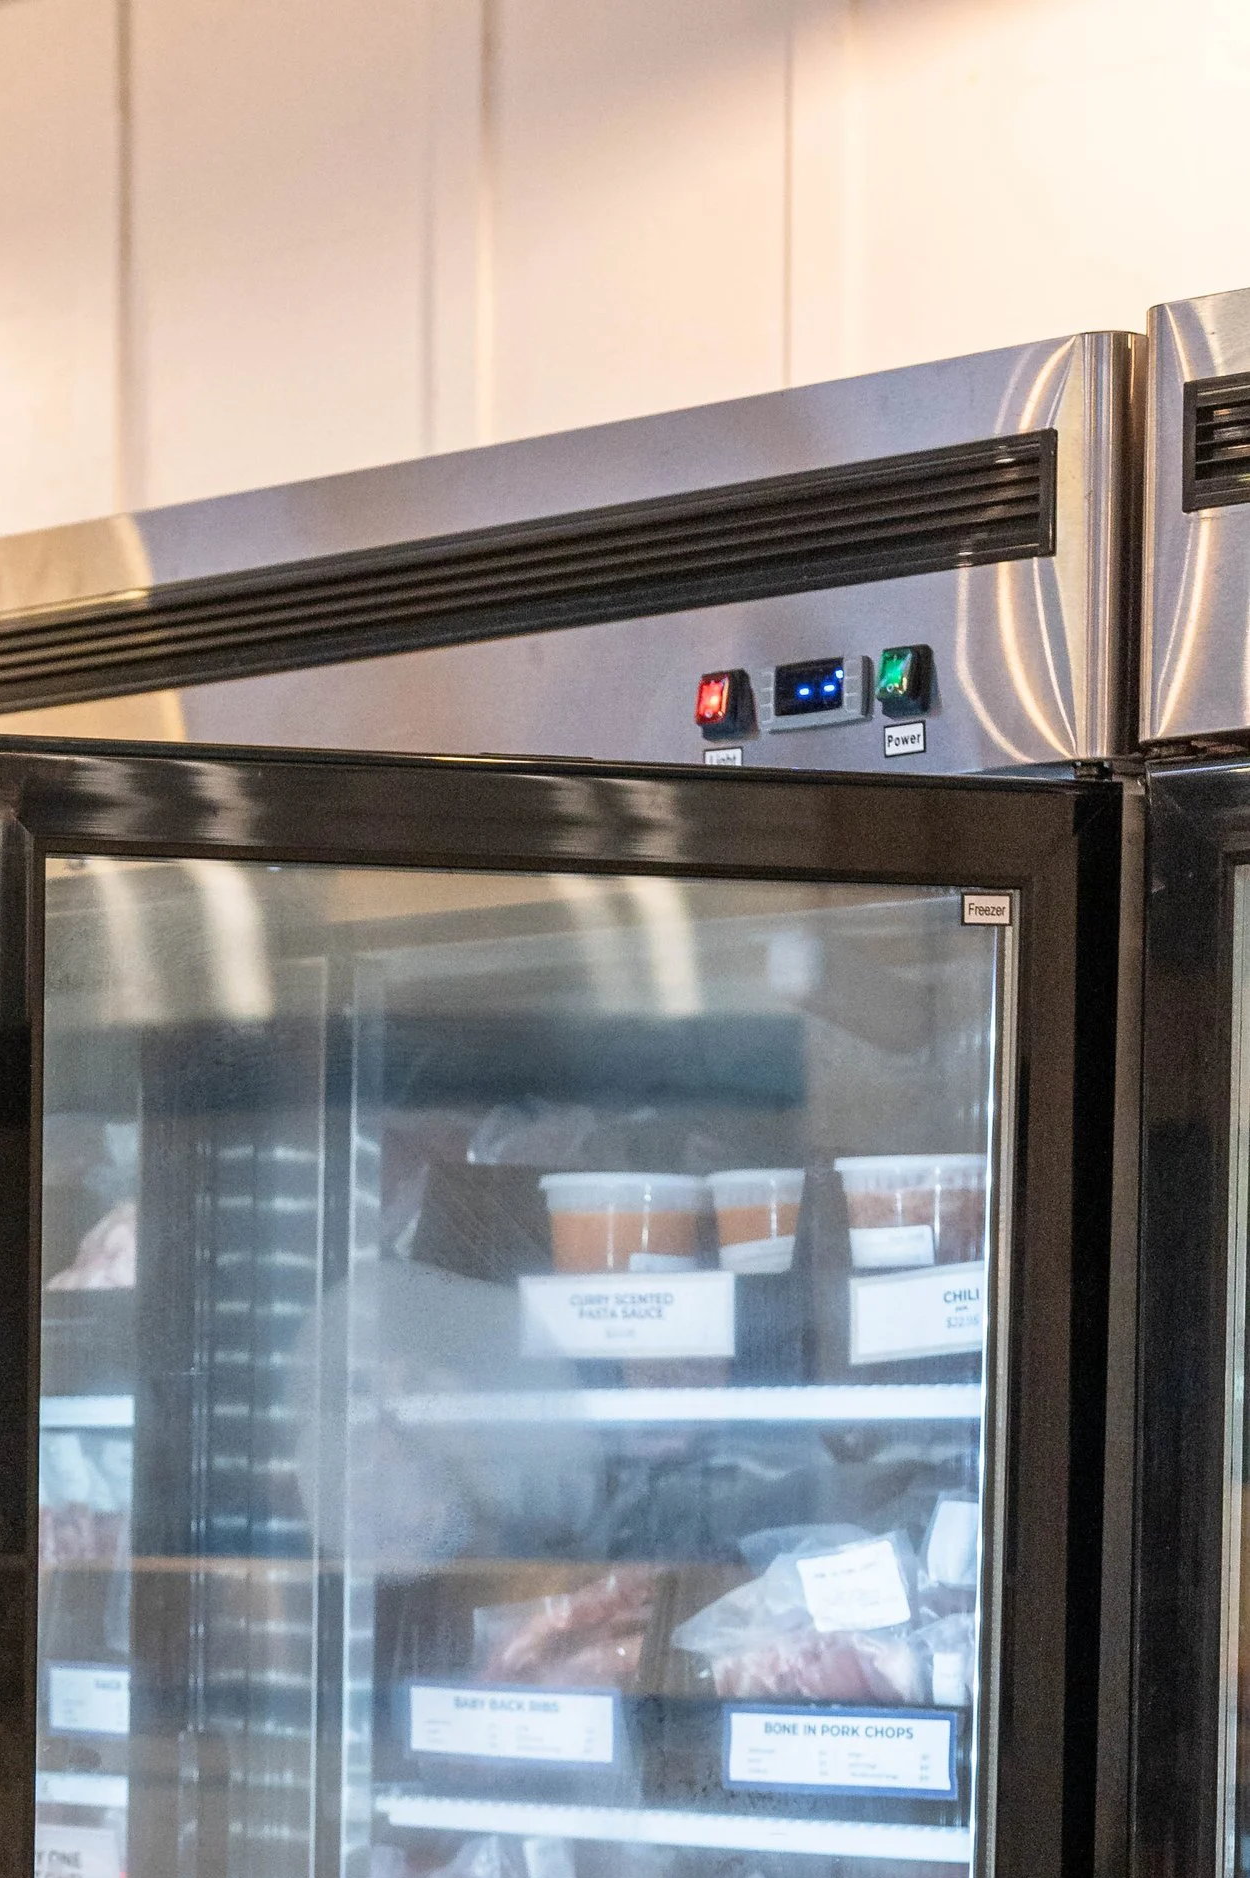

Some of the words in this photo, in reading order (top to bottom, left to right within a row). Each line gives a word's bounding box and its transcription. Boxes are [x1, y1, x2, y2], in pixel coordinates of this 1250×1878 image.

[887, 733, 922, 747] Power
[968, 902, 1006, 917] Freezer
[615, 1292, 675, 1305] SCENTED
[943, 1288, 979, 1303] CHILI
[578, 1306, 618, 1319] PASTA
[621, 1307, 663, 1319] SAUCE
[489, 1698, 524, 1712] BACK
[764, 1721, 799, 1737] BONE
[804, 1722, 816, 1737] IN
[821, 1724, 860, 1738] PORK
[865, 1726, 914, 1740] CHOPS
